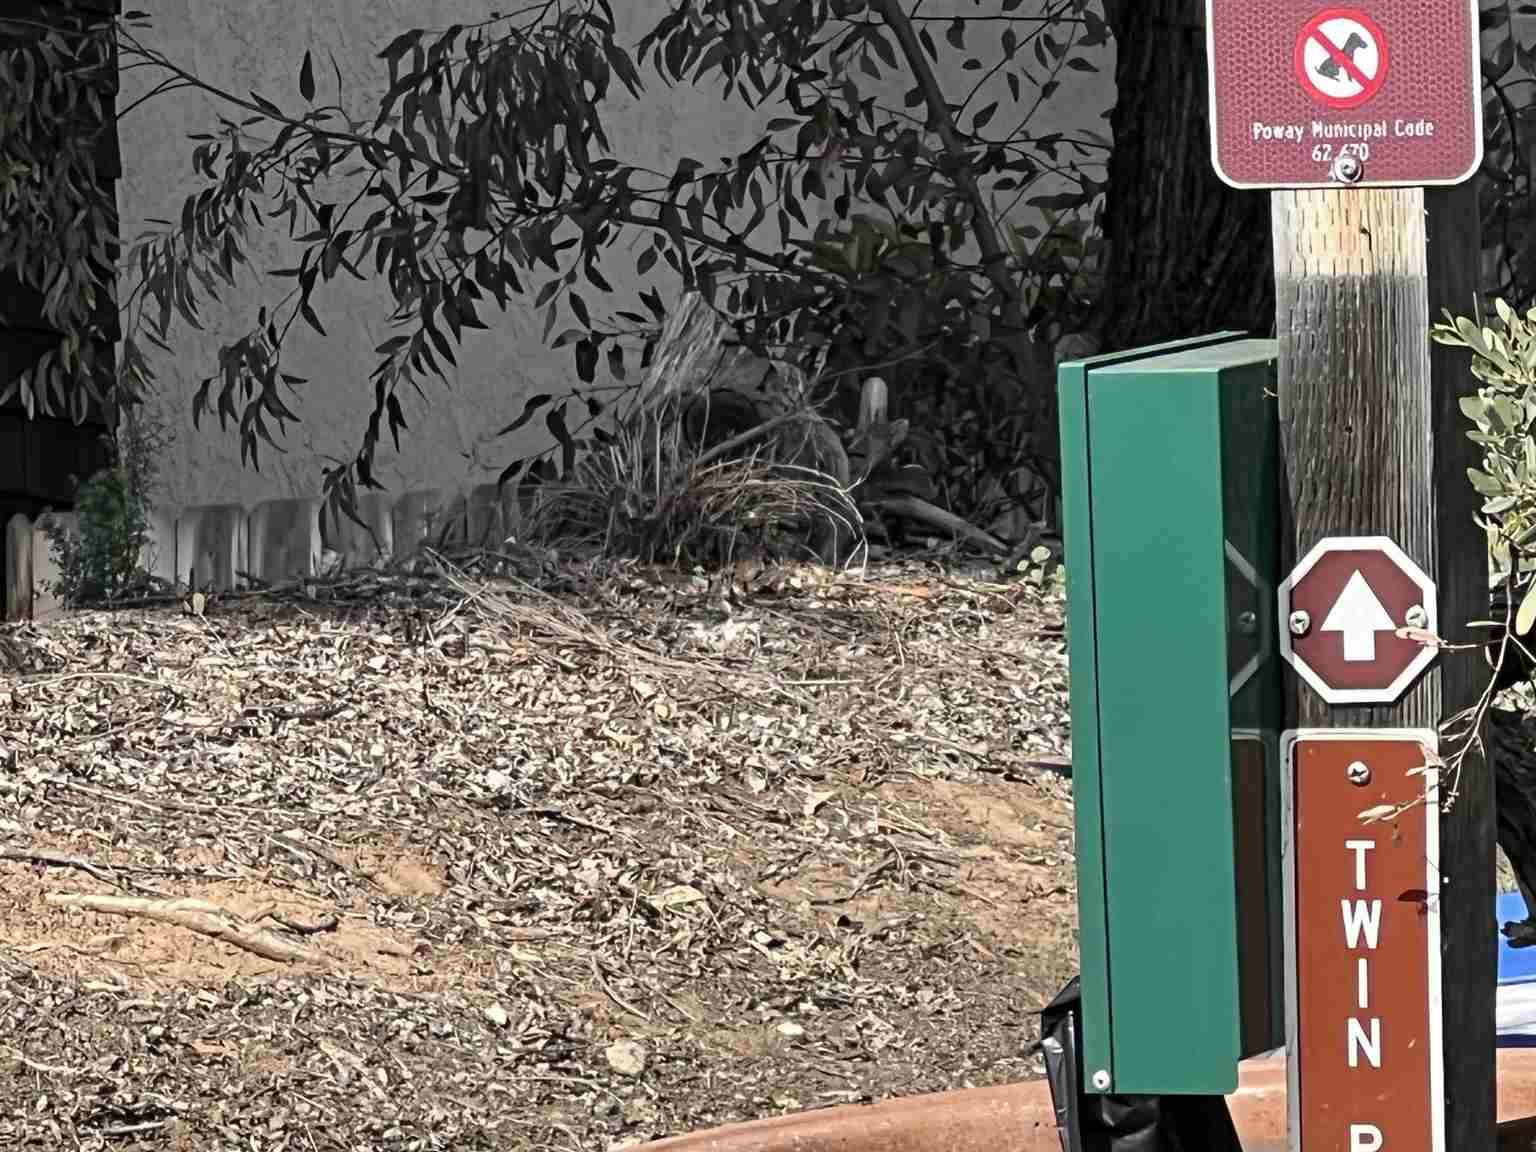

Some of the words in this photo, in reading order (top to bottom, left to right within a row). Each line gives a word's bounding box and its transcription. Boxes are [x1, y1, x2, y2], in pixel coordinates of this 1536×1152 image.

[1252, 121, 1304, 143] Poway
[1311, 120, 1387, 140] Municipal
[1394, 118, 1435, 137] Code
[1340, 839, 1382, 1068] TWIN
